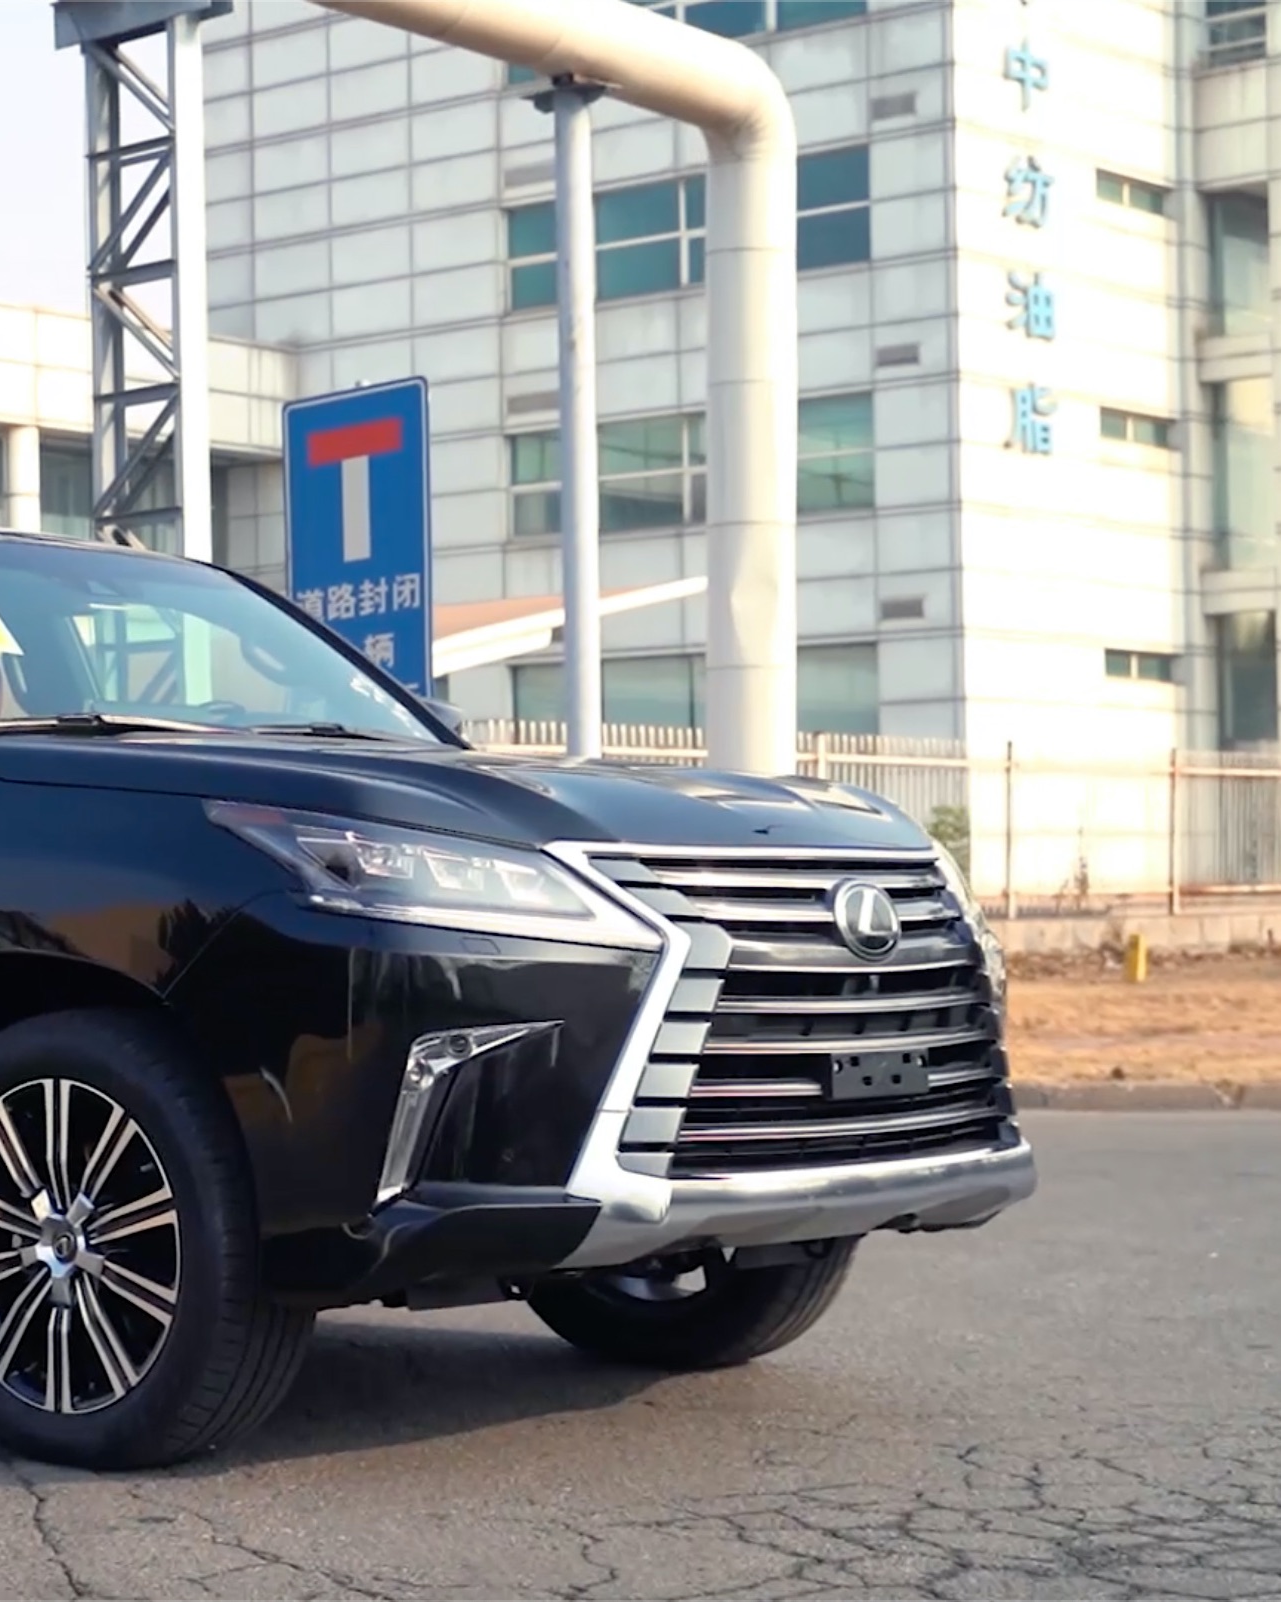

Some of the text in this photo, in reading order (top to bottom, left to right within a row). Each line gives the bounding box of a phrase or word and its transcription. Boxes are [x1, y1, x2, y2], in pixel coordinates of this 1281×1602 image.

[1002, 0, 1058, 455] 中纺油脂
[296, 573, 421, 622] 道路封闭
